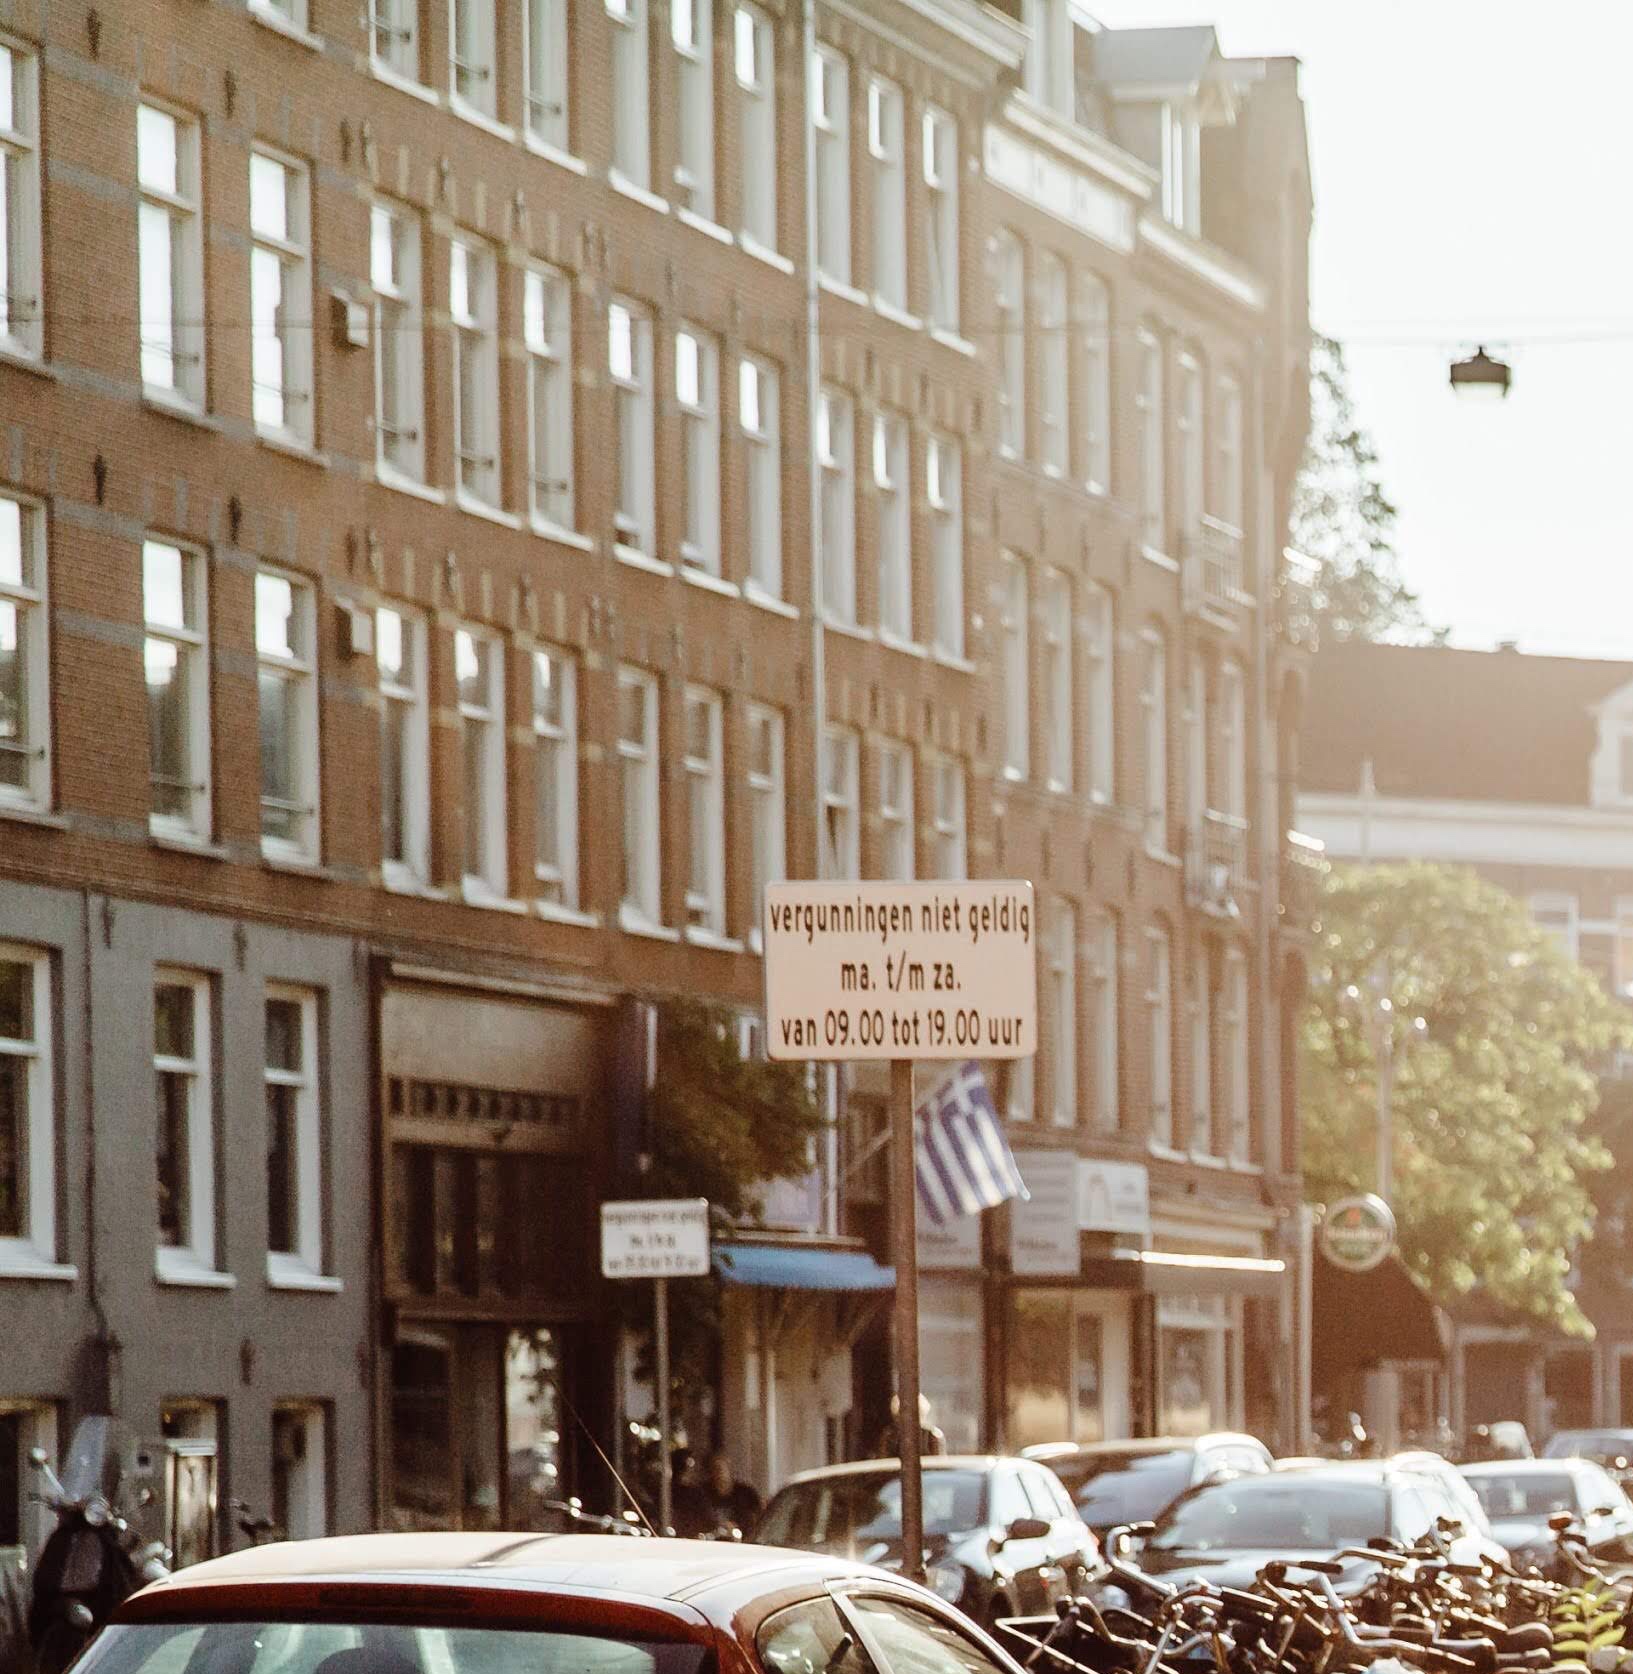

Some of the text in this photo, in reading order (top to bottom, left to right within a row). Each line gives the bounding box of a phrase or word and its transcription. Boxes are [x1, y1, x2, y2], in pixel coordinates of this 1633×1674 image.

[770, 897, 1029, 944] vergunningen niet geldig
[841, 951, 961, 992] ma. t/m za.
[781, 1010, 1022, 1045] van 09.00 tot 19.00 uur
